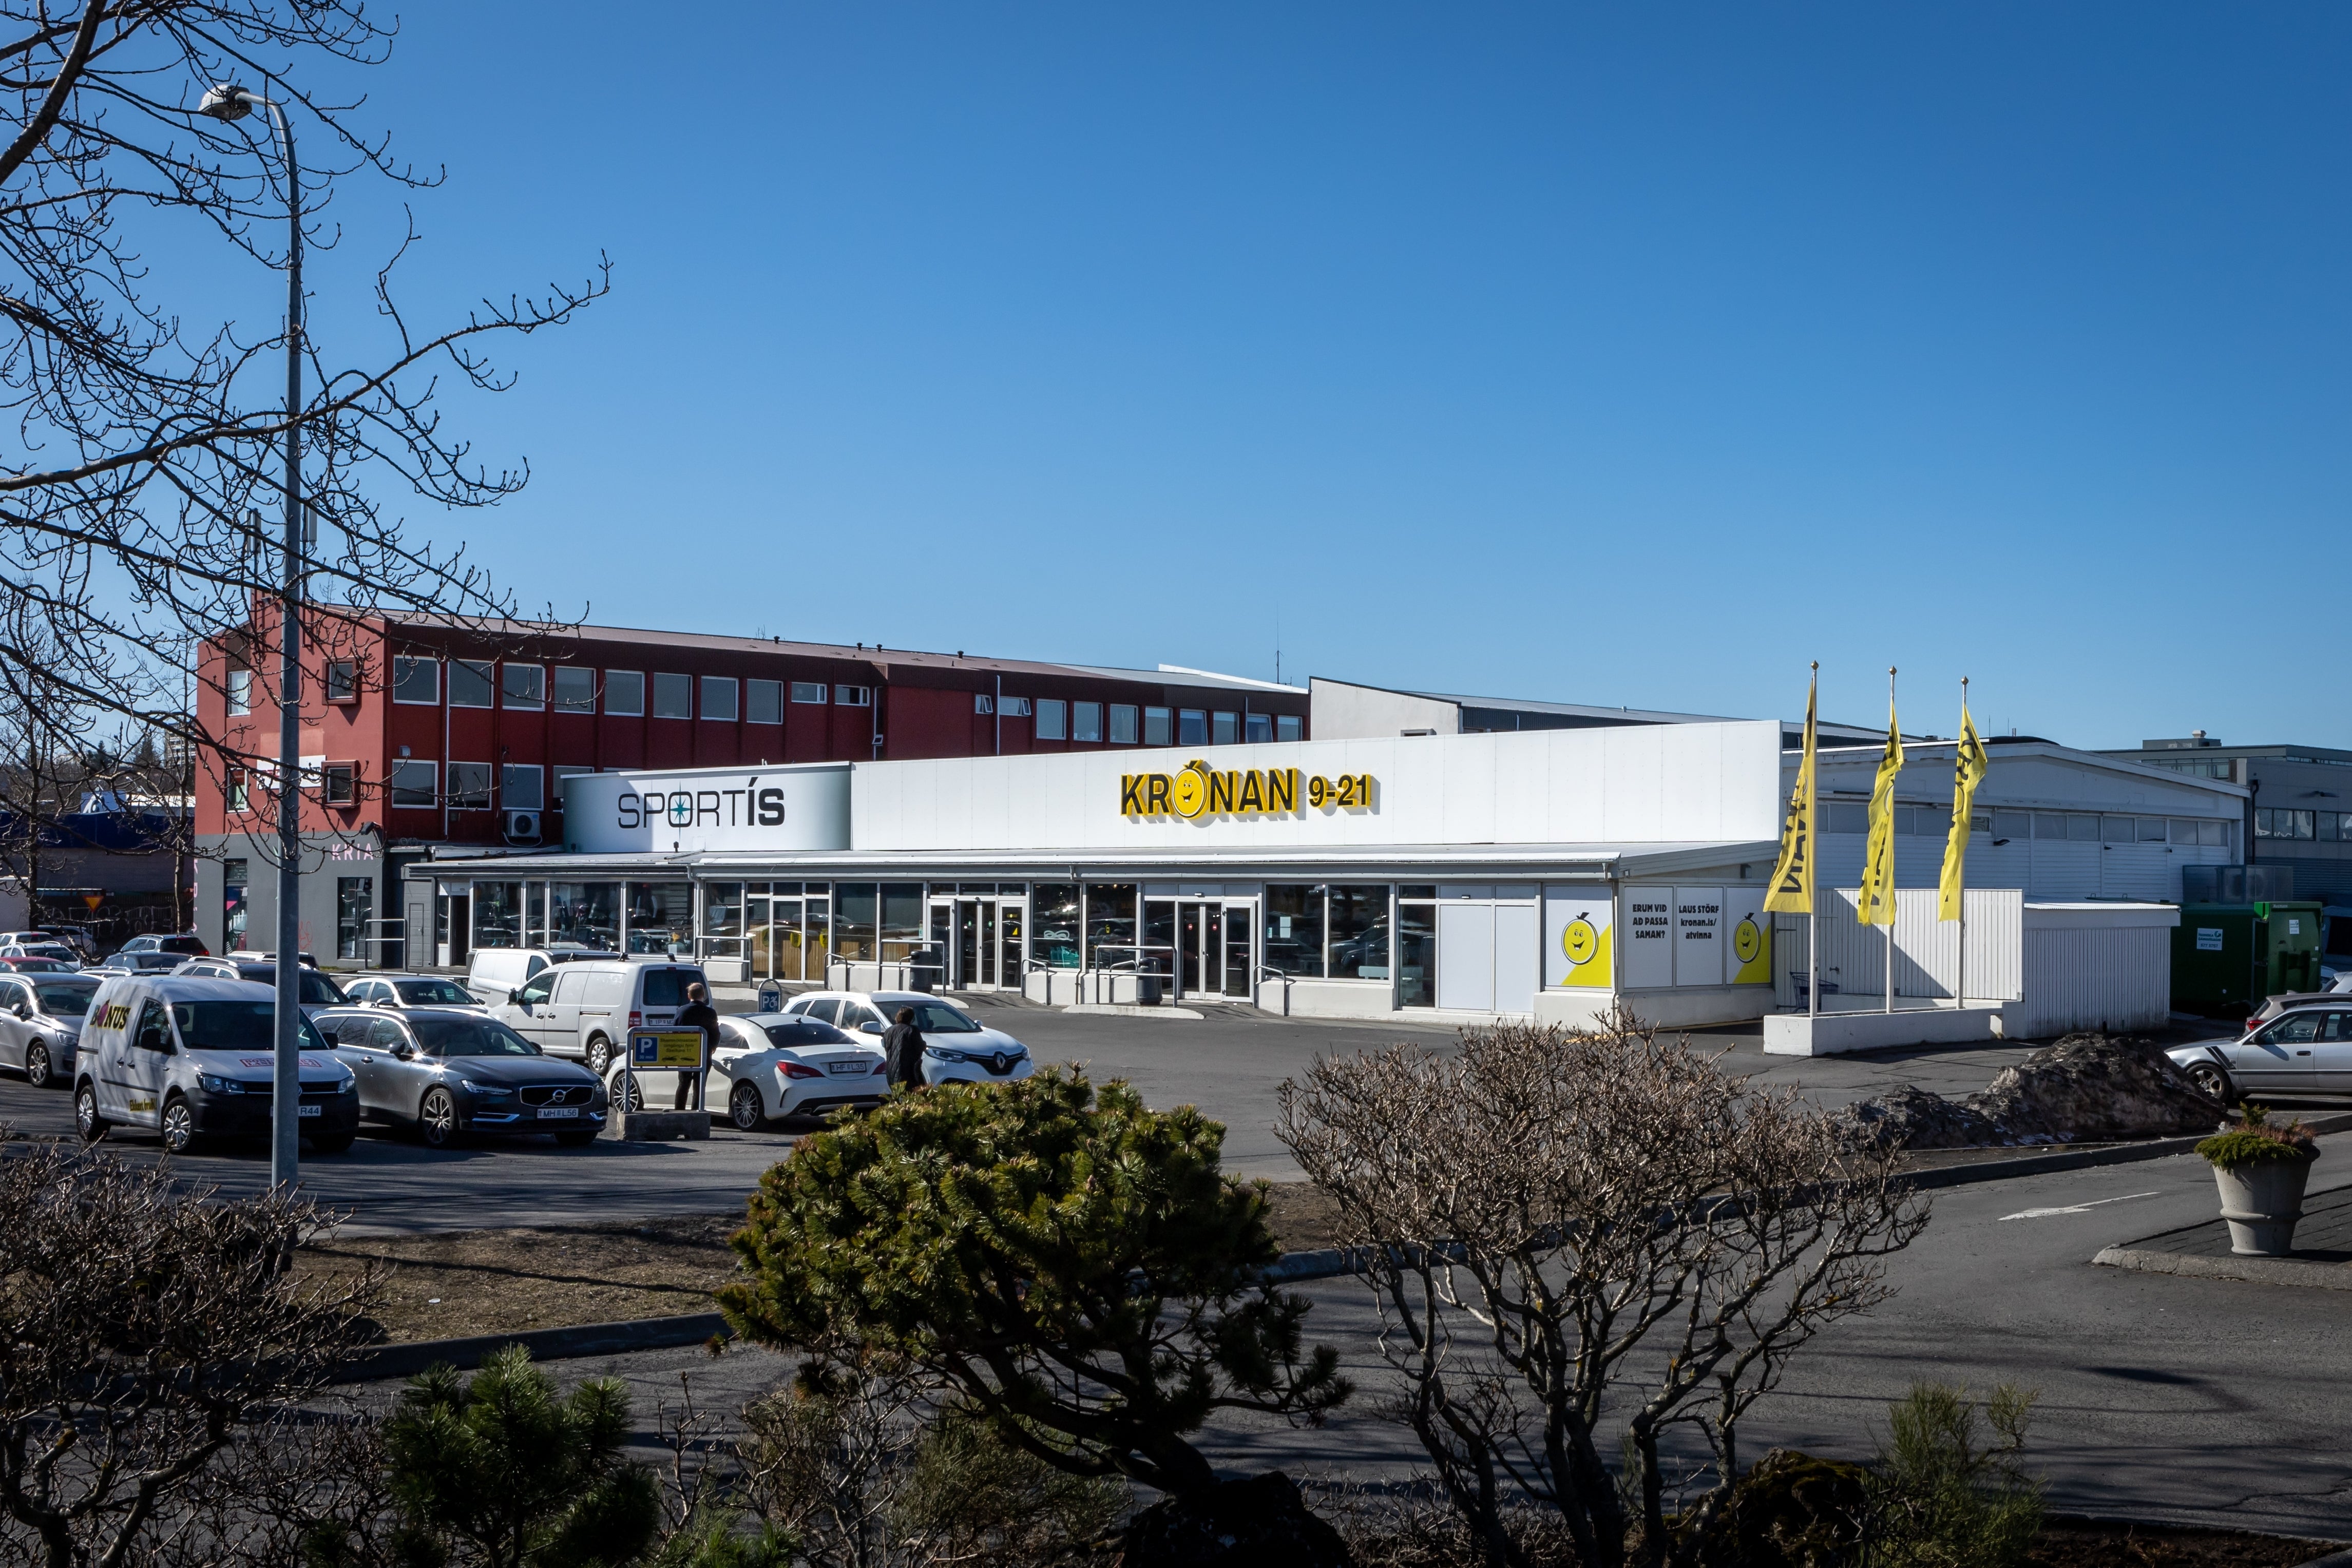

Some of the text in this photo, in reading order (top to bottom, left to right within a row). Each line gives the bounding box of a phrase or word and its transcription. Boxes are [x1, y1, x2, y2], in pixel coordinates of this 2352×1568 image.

[1121, 759, 1372, 820] KRÓNAN 9-21
[618, 777, 786, 829] SPORTÍS
[1632, 904, 1667, 912] ERUM VIÐ
[1678, 903, 1719, 913] LAUS STÖRF
[1632, 917, 1668, 926] AÐ PASSA
[1680, 918, 1717, 926] kronan.is/
[1635, 930, 1666, 939] SAMAN?
[1686, 931, 1712, 940] atvinna
[762, 996, 770, 1008] P
[641, 1038, 653, 1054] P
[300, 1107, 319, 1115] R44
